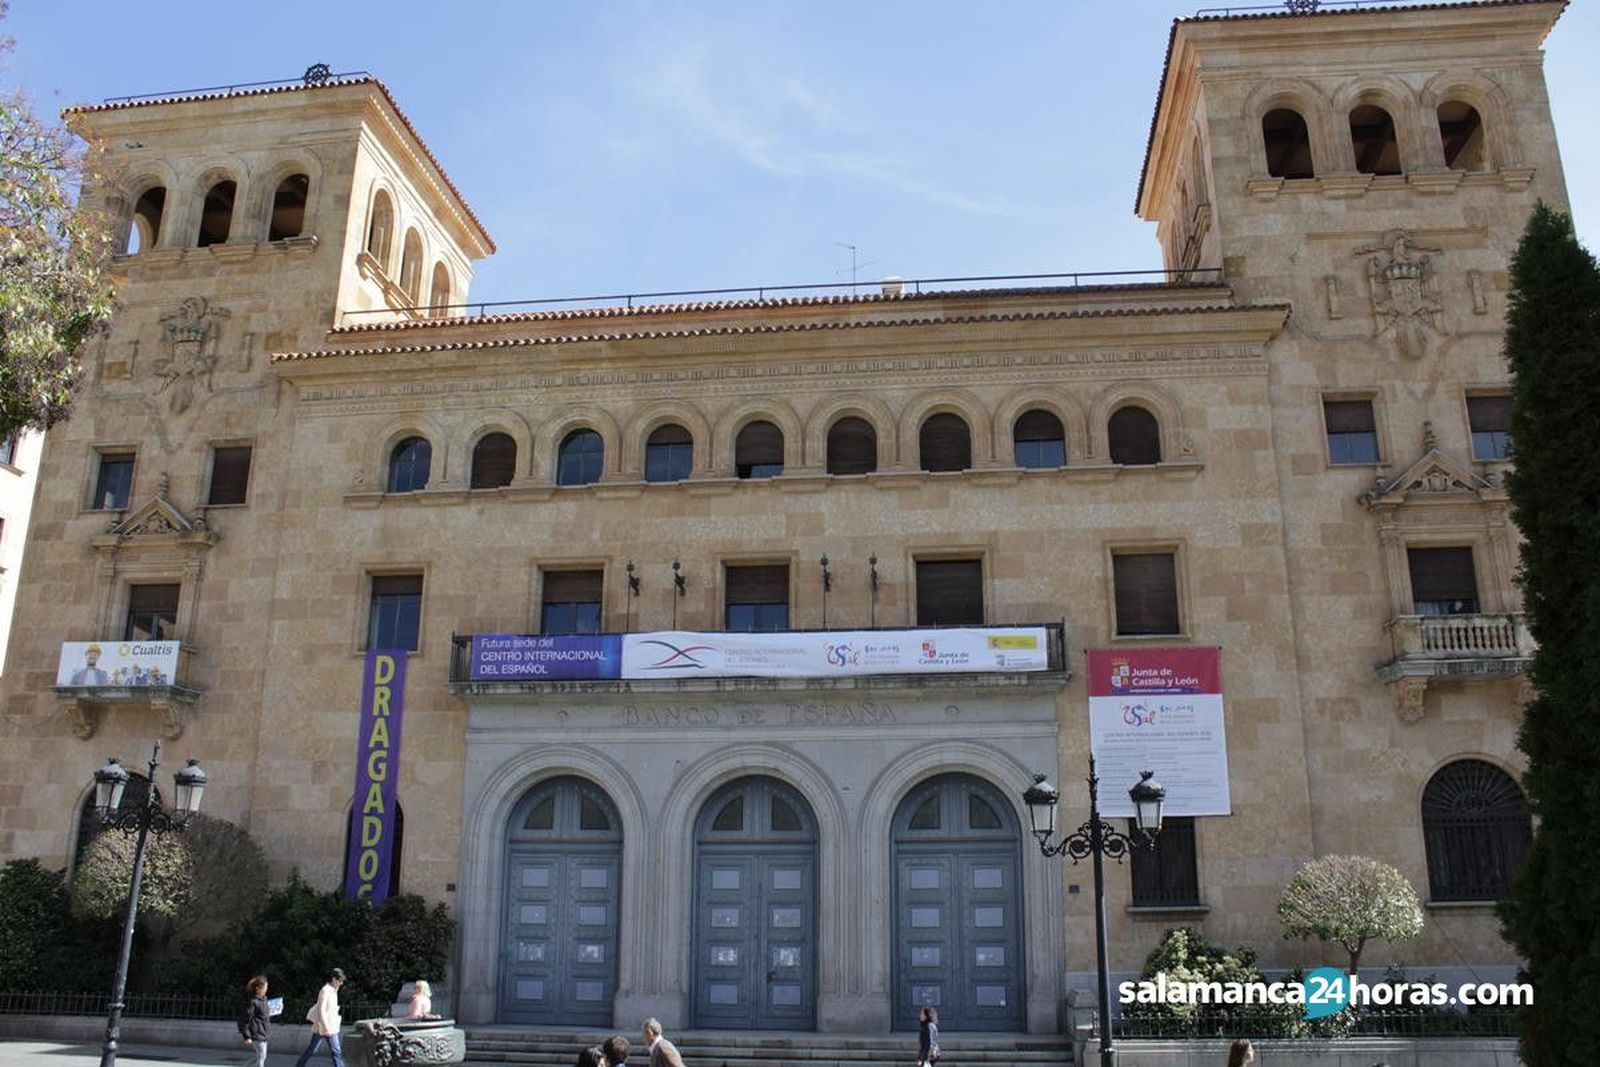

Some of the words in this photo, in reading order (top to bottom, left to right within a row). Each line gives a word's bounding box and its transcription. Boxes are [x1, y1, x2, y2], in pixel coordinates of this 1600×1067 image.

[480, 638, 511, 648] Futura
[513, 638, 536, 648] sede
[538, 637, 554, 647] del
[131, 644, 172, 656] Cualtis
[481, 651, 522, 661] CENTRO
[524, 650, 606, 661] INTERNACIONAL
[480, 664, 498, 674] DEL
[501, 662, 548, 674] ESPAÑOL
[1132, 668, 1158, 677] Junta
[1160, 668, 1172, 676] de
[1132, 678, 1165, 687] Castilla
[1167, 678, 1173, 687] y
[1175, 677, 1199, 686] León
[623, 705, 721, 727] BANCO
[737, 708, 767, 725] DE
[786, 702, 897, 725] ESPAÑA
